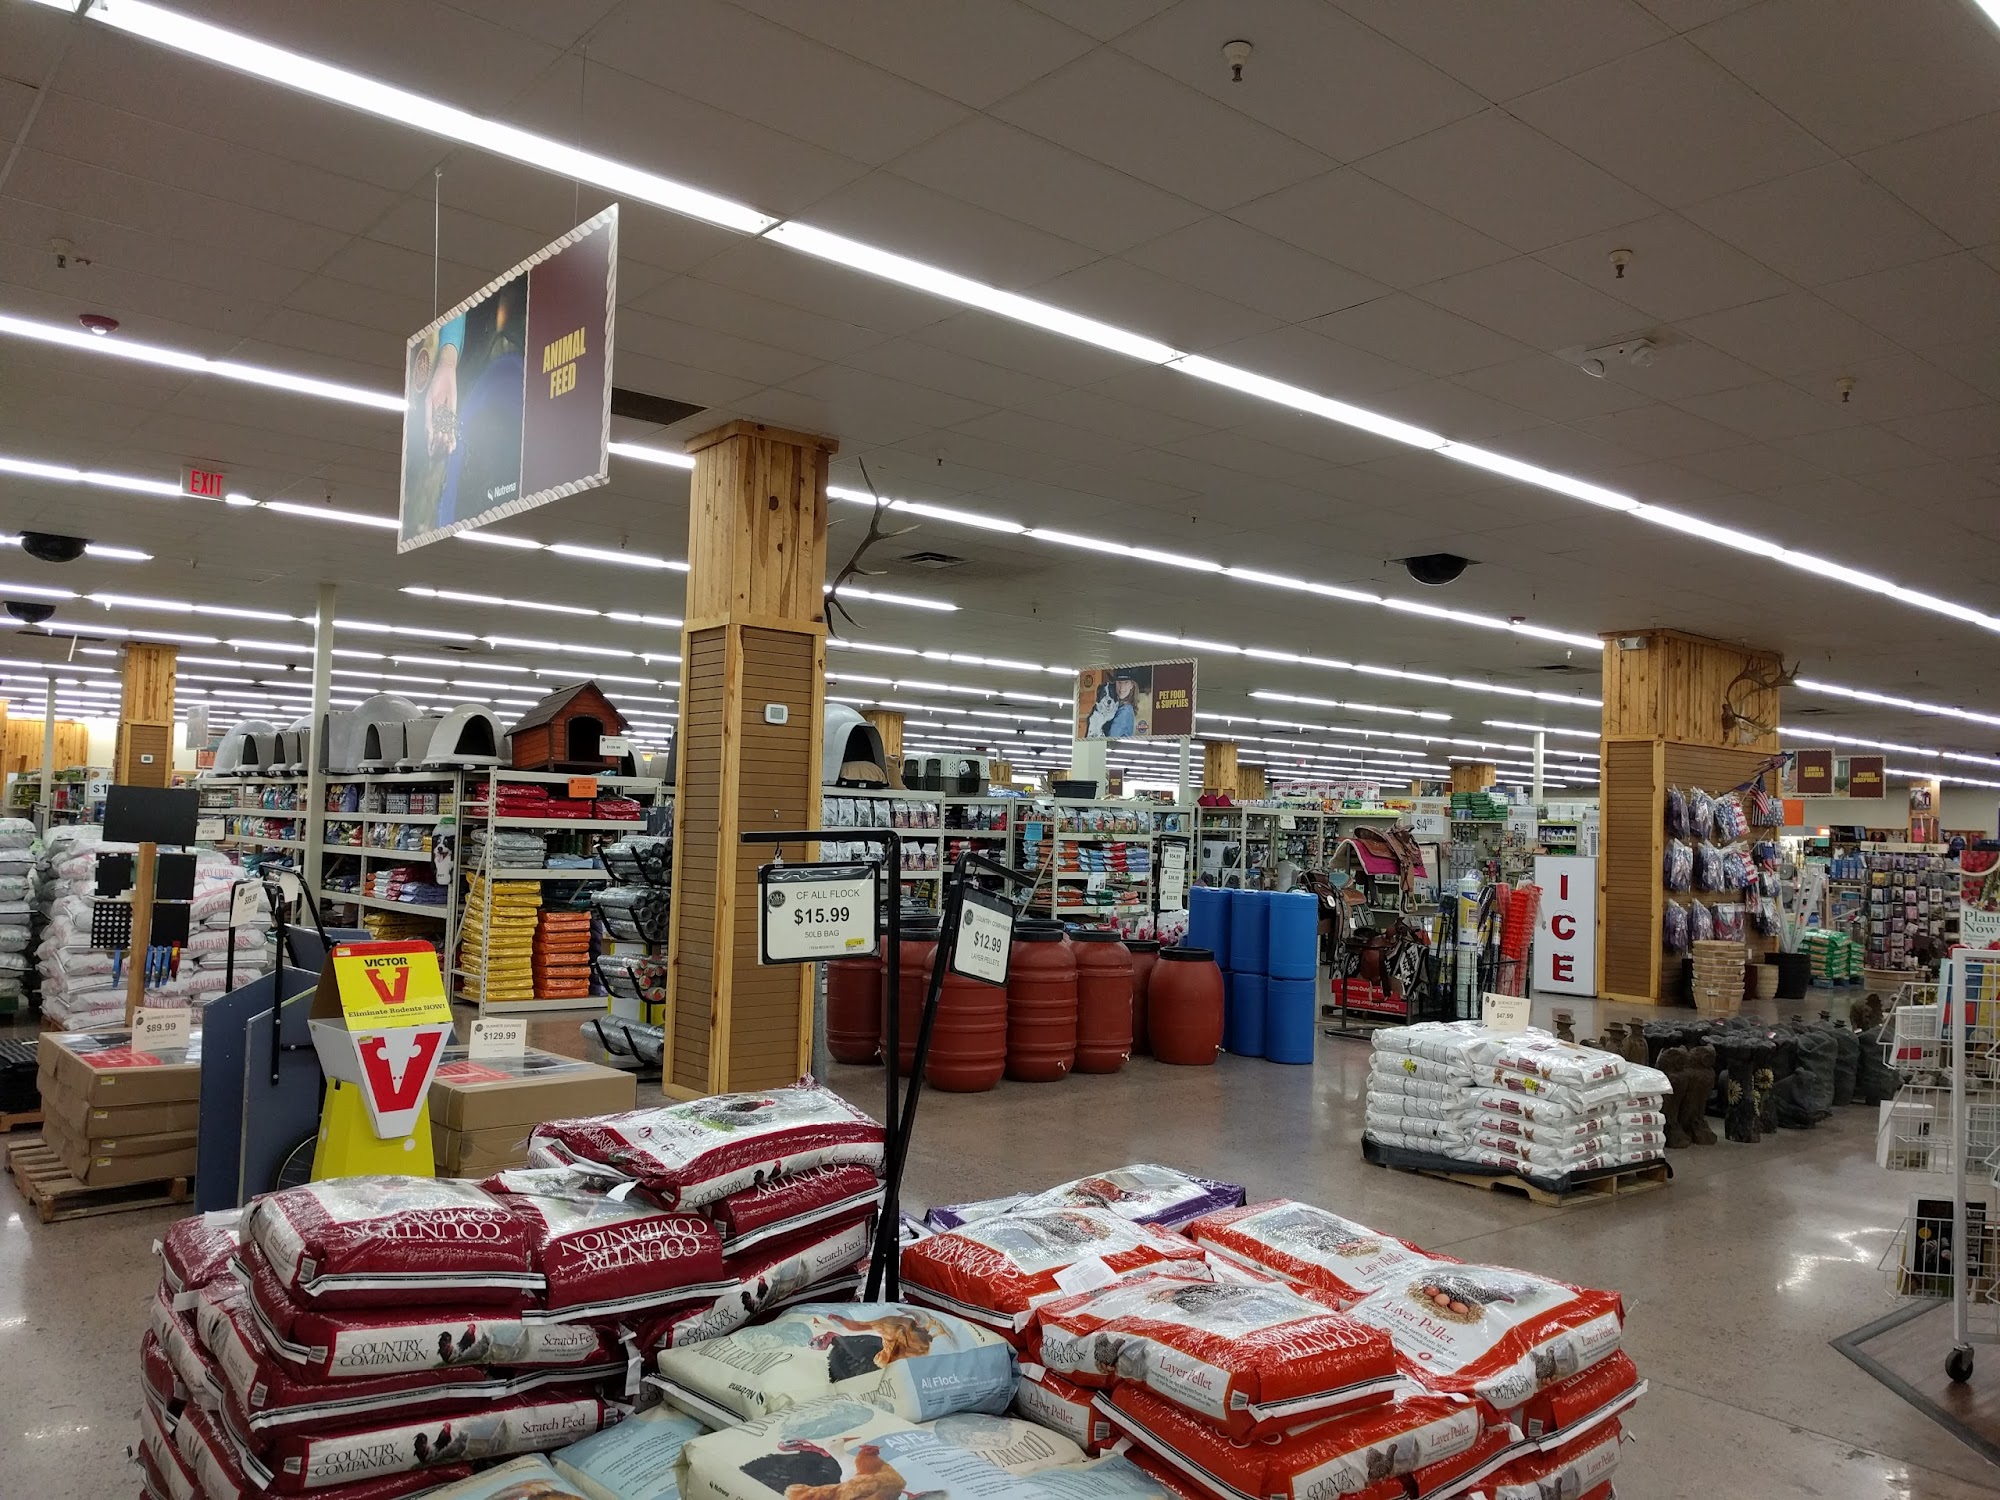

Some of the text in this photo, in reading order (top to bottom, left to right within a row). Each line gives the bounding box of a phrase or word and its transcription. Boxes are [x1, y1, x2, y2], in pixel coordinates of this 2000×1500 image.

[542, 326, 586, 374] ANIMAL
[549, 362, 577, 399] FEED
[190, 469, 224, 496] EXIT
[494, 482, 516, 498] Nutrena
[1156, 698, 1189, 709] & SUPPLIES
[1159, 690, 1186, 700] PET FOOD
[796, 888, 860, 900] CF ALL FLOCK
[794, 906, 850, 926] $15.99
[1964, 911, 2000, 923] Plant
[804, 929, 840, 938] 50LB BAG
[1551, 870, 1576, 982] ICE
[1964, 922, 1996, 934] Now
[974, 930, 1002, 953] $12.99
[364, 957, 408, 967] VICTOR
[971, 953, 985, 962] LAYER
[348, 1009, 388, 1017] Eliminate
[146, 1022, 176, 1033] $89.99
[484, 1032, 516, 1040] $129.99
[560, 1218, 708, 1257] COMPANION
[582, 1236, 701, 1272] COUNTRY
[816, 1248, 843, 1266] Scratch
[844, 1236, 861, 1254] Feed
[542, 1333, 578, 1346] Scratch
[1418, 1317, 1456, 1345] Pellet
[351, 1338, 424, 1355] COUNTRY
[1276, 1328, 1370, 1362] COUNTRY
[340, 1350, 428, 1367] COMPANION
[921, 1373, 960, 1389] All Flock
[1160, 1356, 1212, 1390] Layer Pellet
[728, 1382, 756, 1400] Nutrena
[1028, 1393, 1050, 1414] Layer
[1051, 1404, 1075, 1426] Pellet
[521, 1414, 586, 1434] Scratch Feed
[885, 1435, 908, 1449] All
[1430, 1423, 1470, 1447] Layer Pellet
[325, 1442, 398, 1465] COUNTRY
[315, 1452, 405, 1477] COMPANION
[714, 1484, 730, 1497] Nutrena
[1307, 1467, 1351, 1497] COUNTRY
